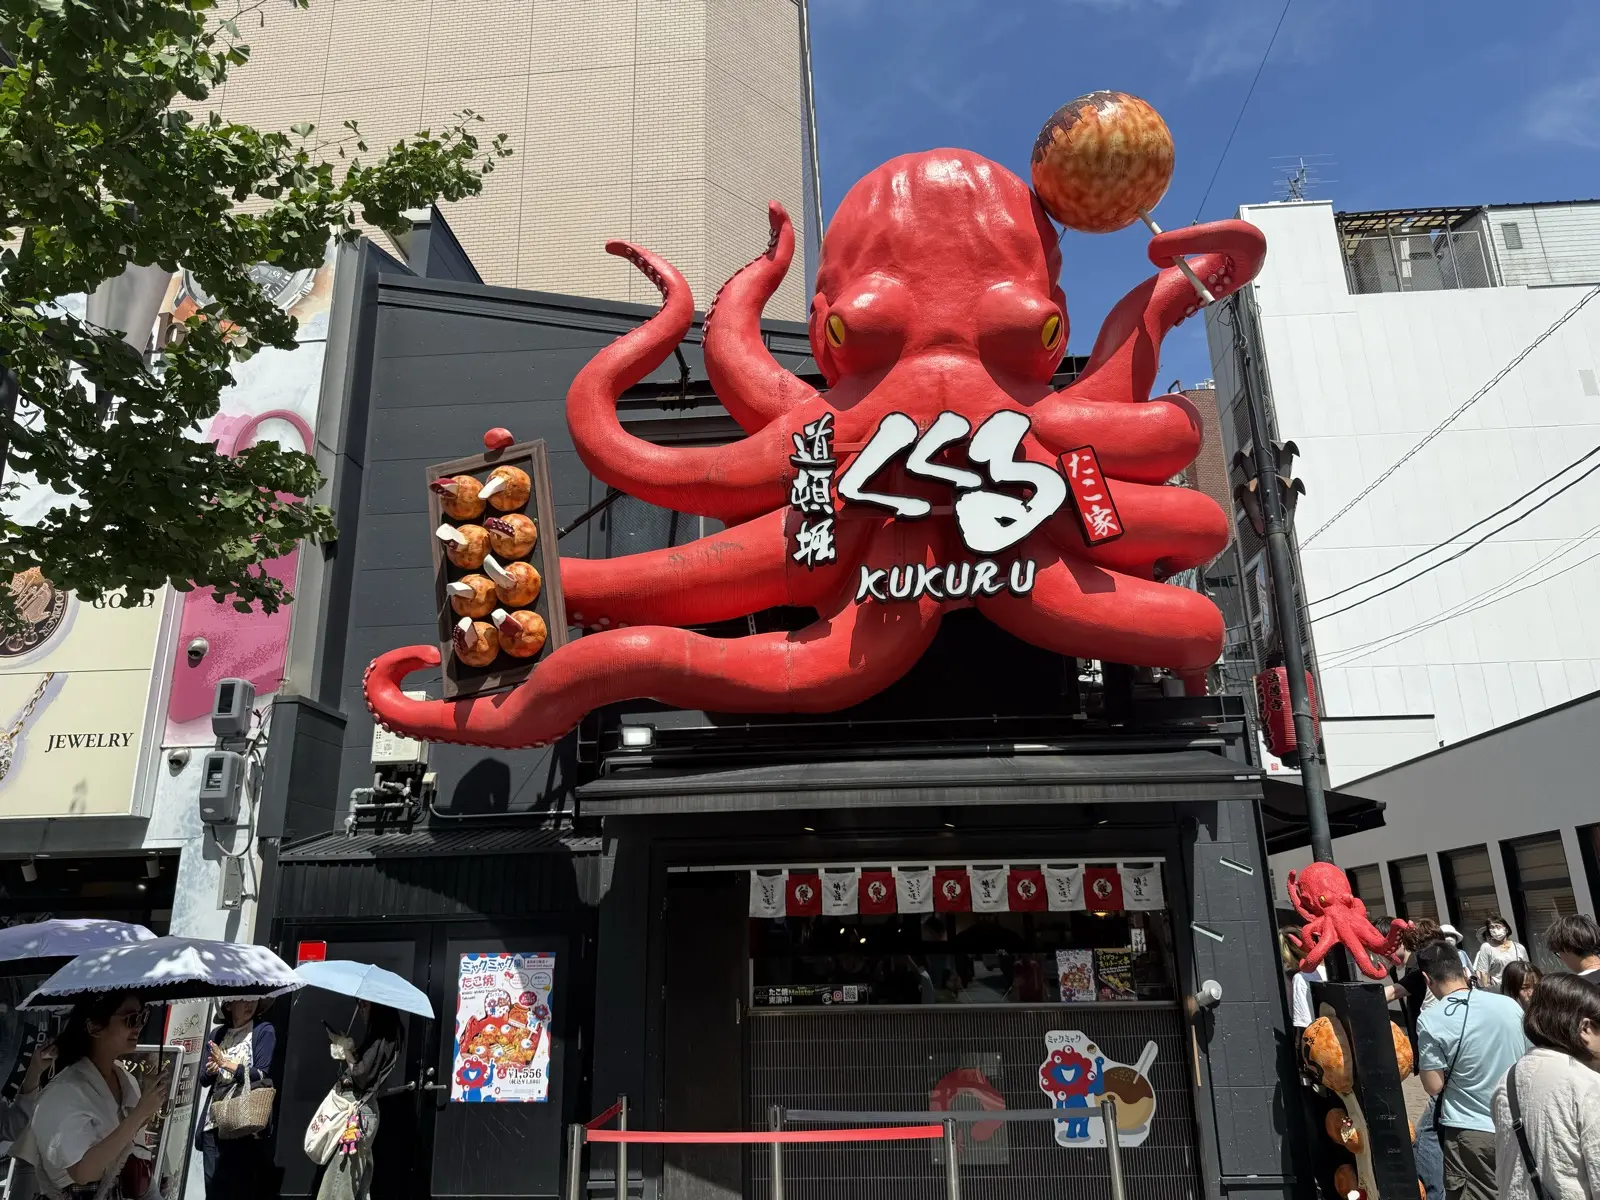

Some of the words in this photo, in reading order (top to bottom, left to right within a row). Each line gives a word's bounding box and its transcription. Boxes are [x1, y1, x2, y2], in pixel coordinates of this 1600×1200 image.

[791, 412, 837, 566] 道頓堀
[838, 409, 1068, 553] くくる
[1067, 452, 1118, 538] たこ家
[855, 559, 1037, 601] KUKURU
[92, 591, 155, 609] GOD
[45, 732, 134, 753] JEWELRY
[1047, 1034, 1082, 1044] ミャクミャク
[508, 1068, 542, 1080] ¥1,556
